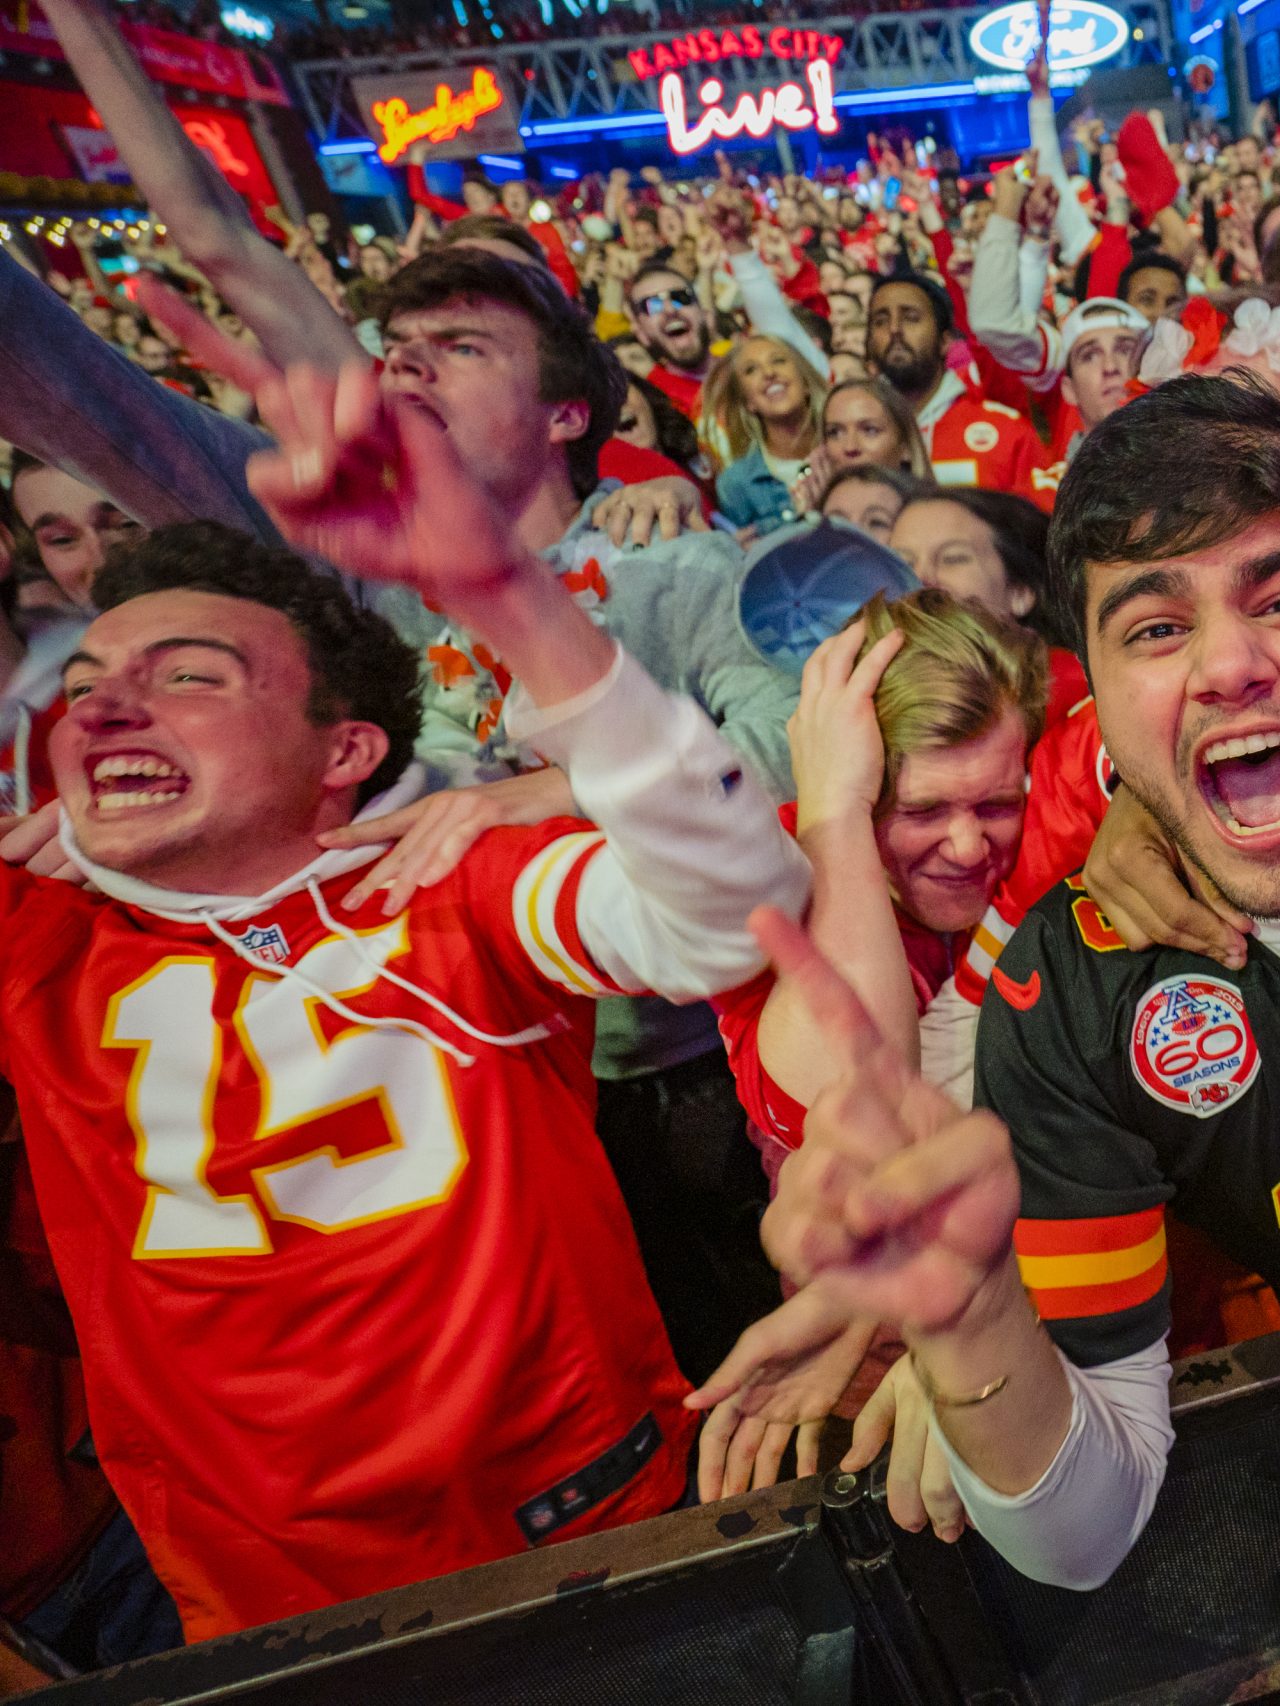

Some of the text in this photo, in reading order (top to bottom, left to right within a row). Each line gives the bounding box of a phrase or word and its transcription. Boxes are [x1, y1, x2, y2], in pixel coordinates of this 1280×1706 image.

[628, 24, 844, 80] KANSAS CITY
[660, 57, 839, 156] Live!
[1136, 1010, 1152, 1046] 1960
[1155, 1024, 1243, 1076] 60
[100, 911, 469, 1260] 15
[1173, 1056, 1241, 1088] SEASONS
